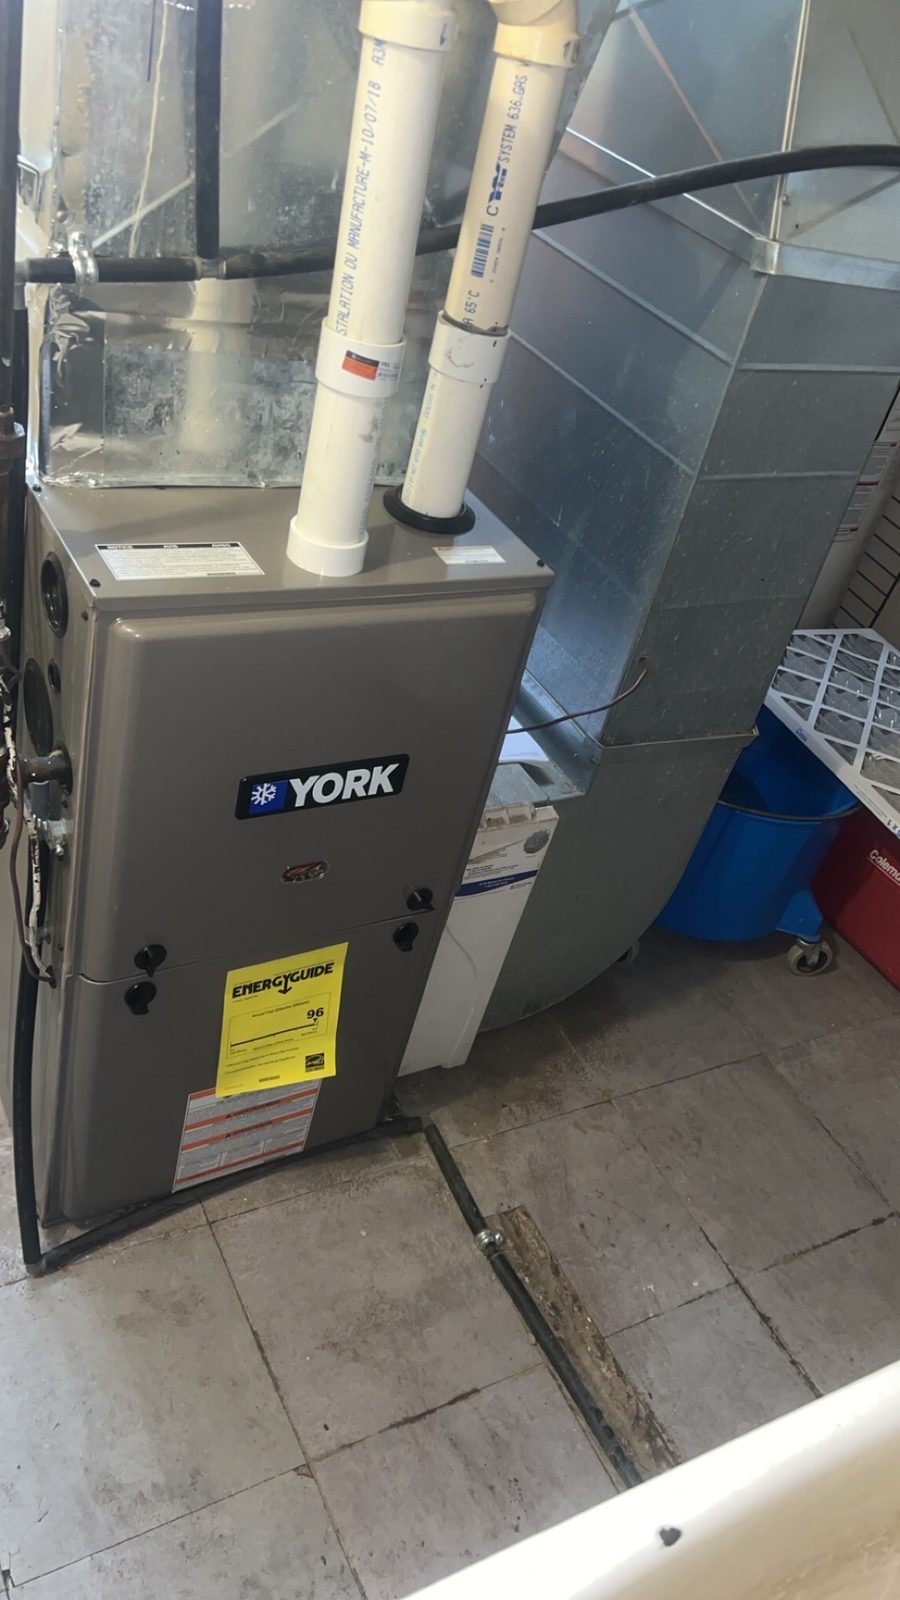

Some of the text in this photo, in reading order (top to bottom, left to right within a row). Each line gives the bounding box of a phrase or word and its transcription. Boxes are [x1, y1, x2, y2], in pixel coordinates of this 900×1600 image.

[498, 124, 517, 164] SYSTEM
[344, 252, 358, 270] DU
[289, 763, 400, 808] YORK
[231, 962, 335, 999] ENERGYGUIDE
[306, 1007, 325, 1020] 96
